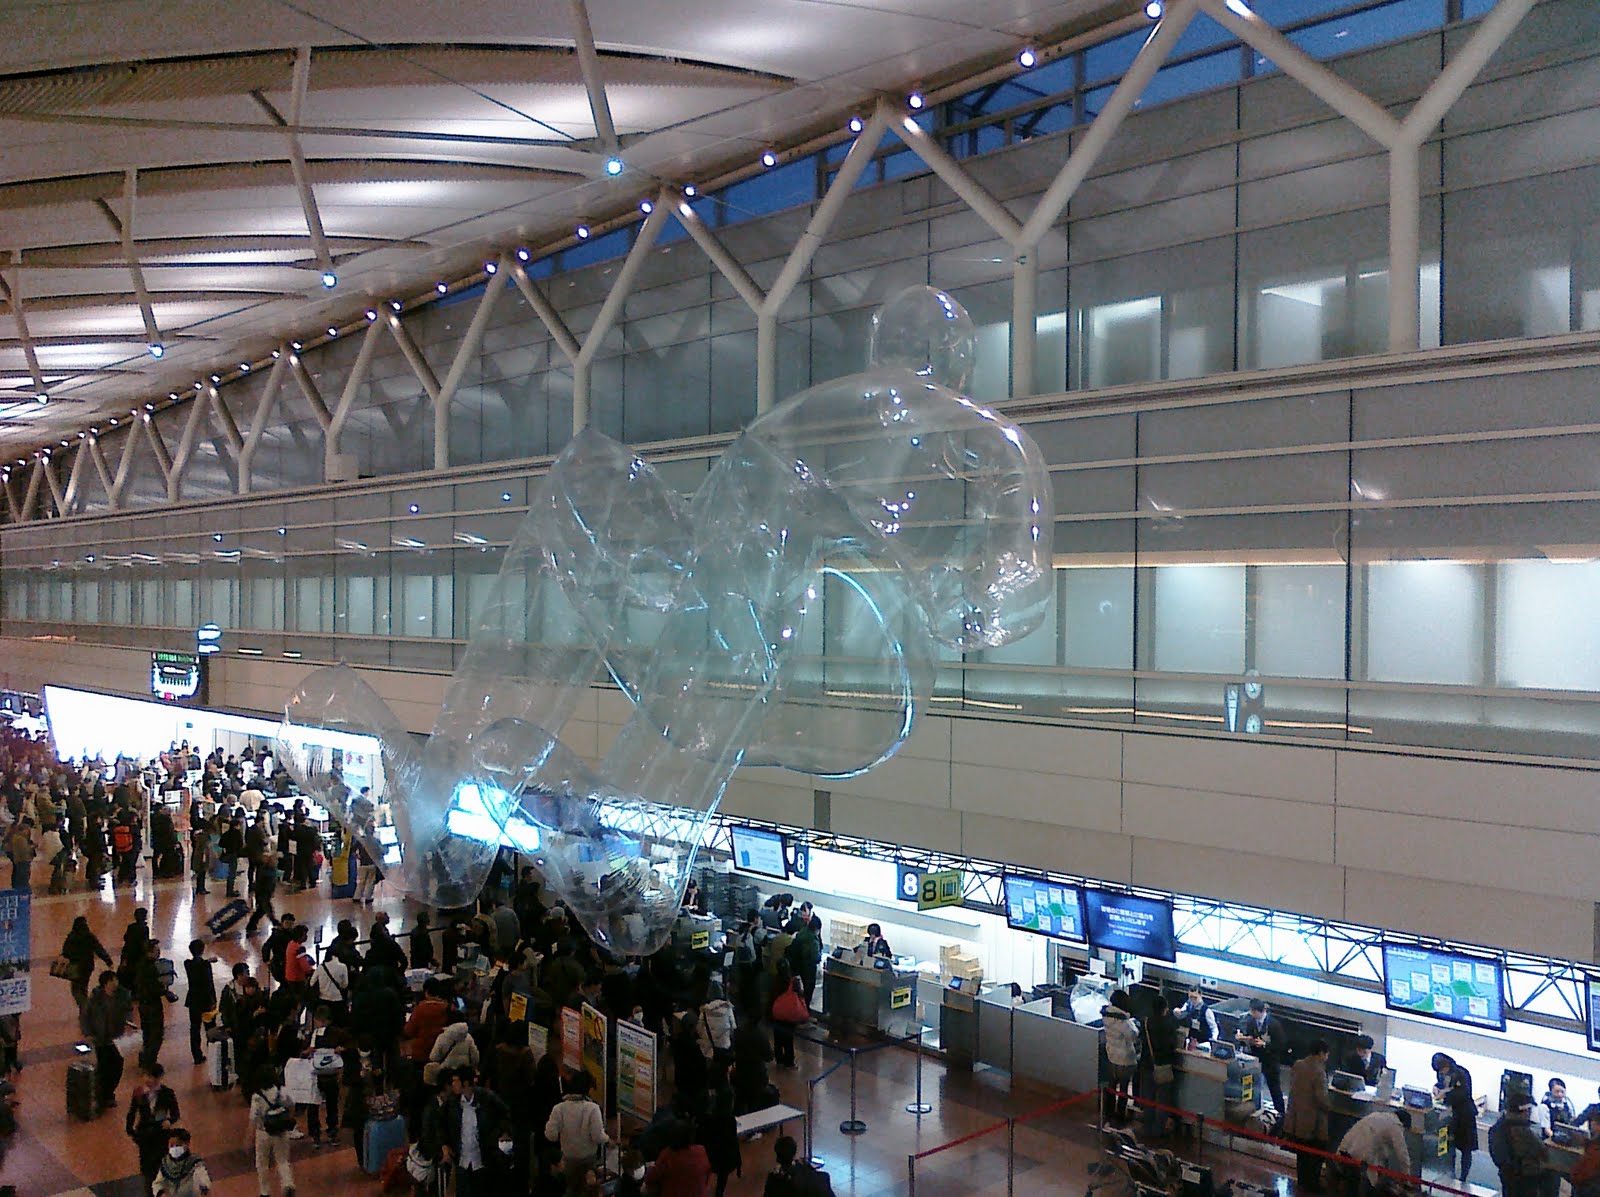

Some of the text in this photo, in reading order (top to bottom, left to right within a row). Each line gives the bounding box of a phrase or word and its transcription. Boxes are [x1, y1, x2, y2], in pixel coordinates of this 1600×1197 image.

[797, 852, 805, 873] 8
[903, 873, 918, 896] 8
[922, 880, 937, 902] 8
